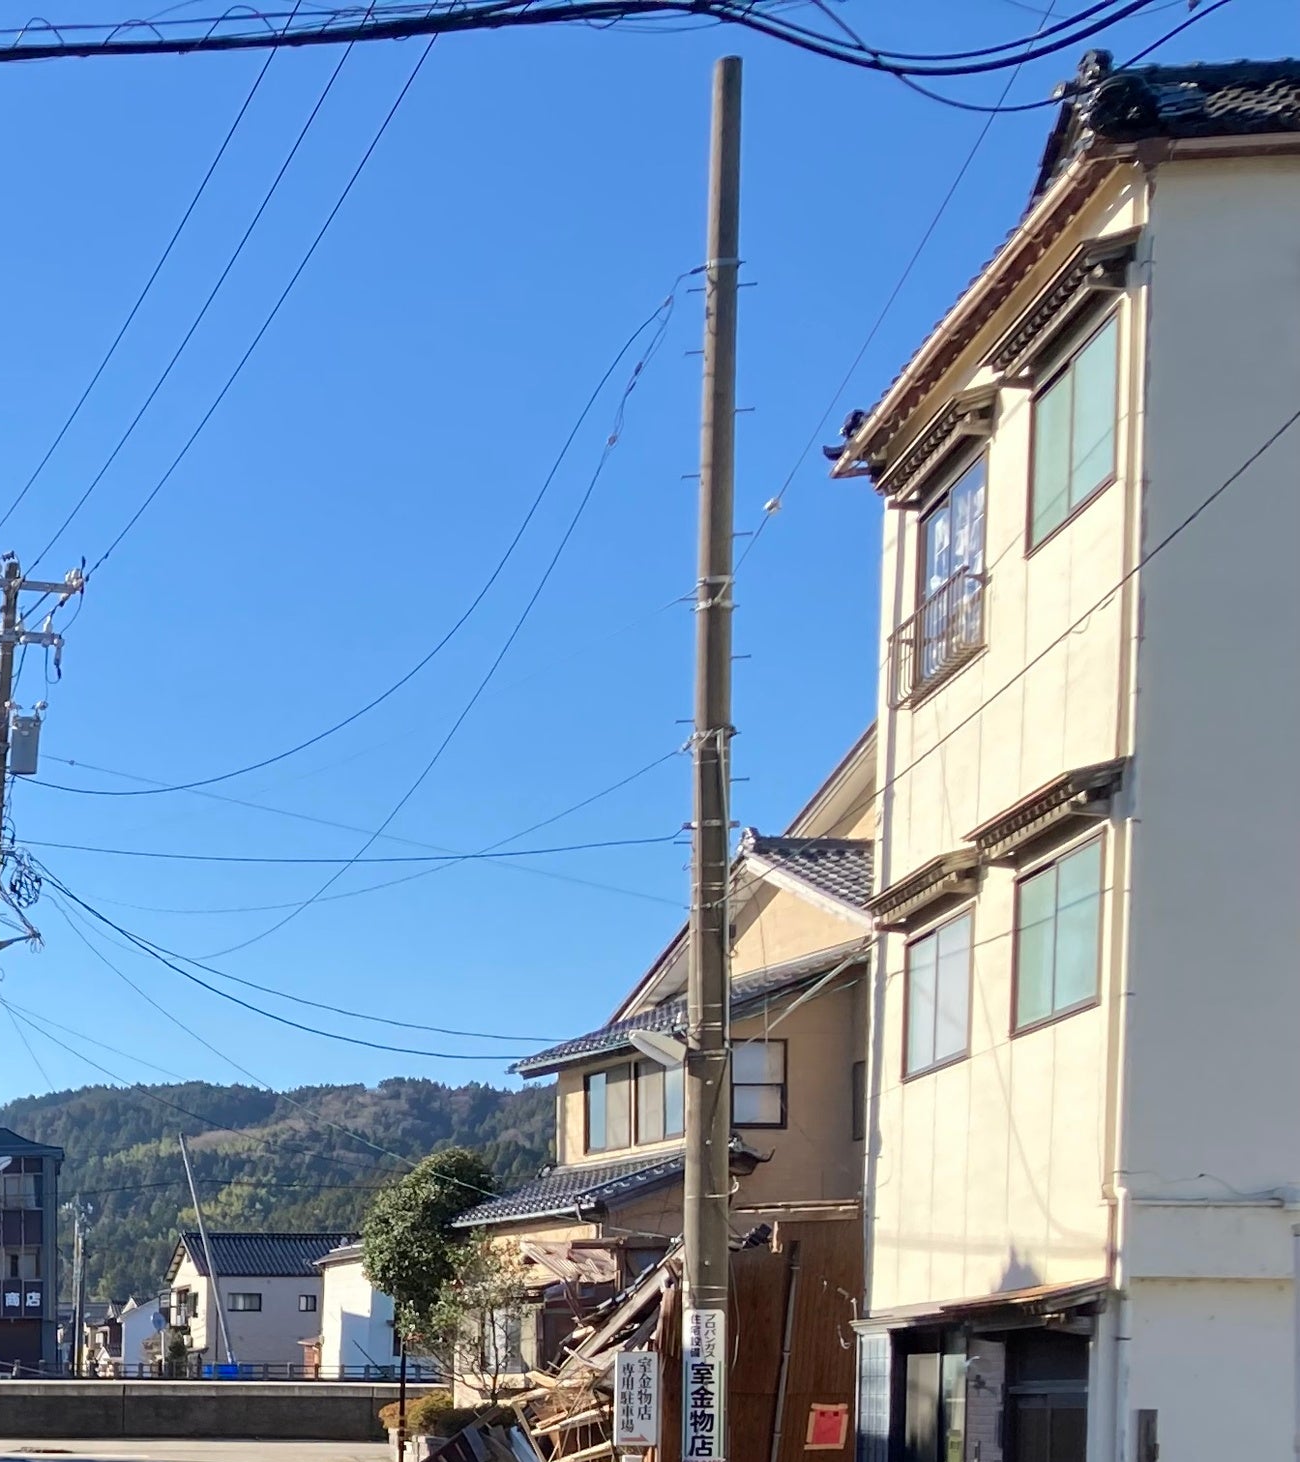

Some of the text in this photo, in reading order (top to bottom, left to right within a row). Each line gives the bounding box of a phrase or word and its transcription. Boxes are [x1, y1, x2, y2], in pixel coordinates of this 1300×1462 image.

[704, 1313, 717, 1358] プロパンガス
[620, 1362, 635, 1433] 専用駐車場
[638, 1356, 653, 1421] 室金物店
[689, 1361, 716, 1457] 室金物店
